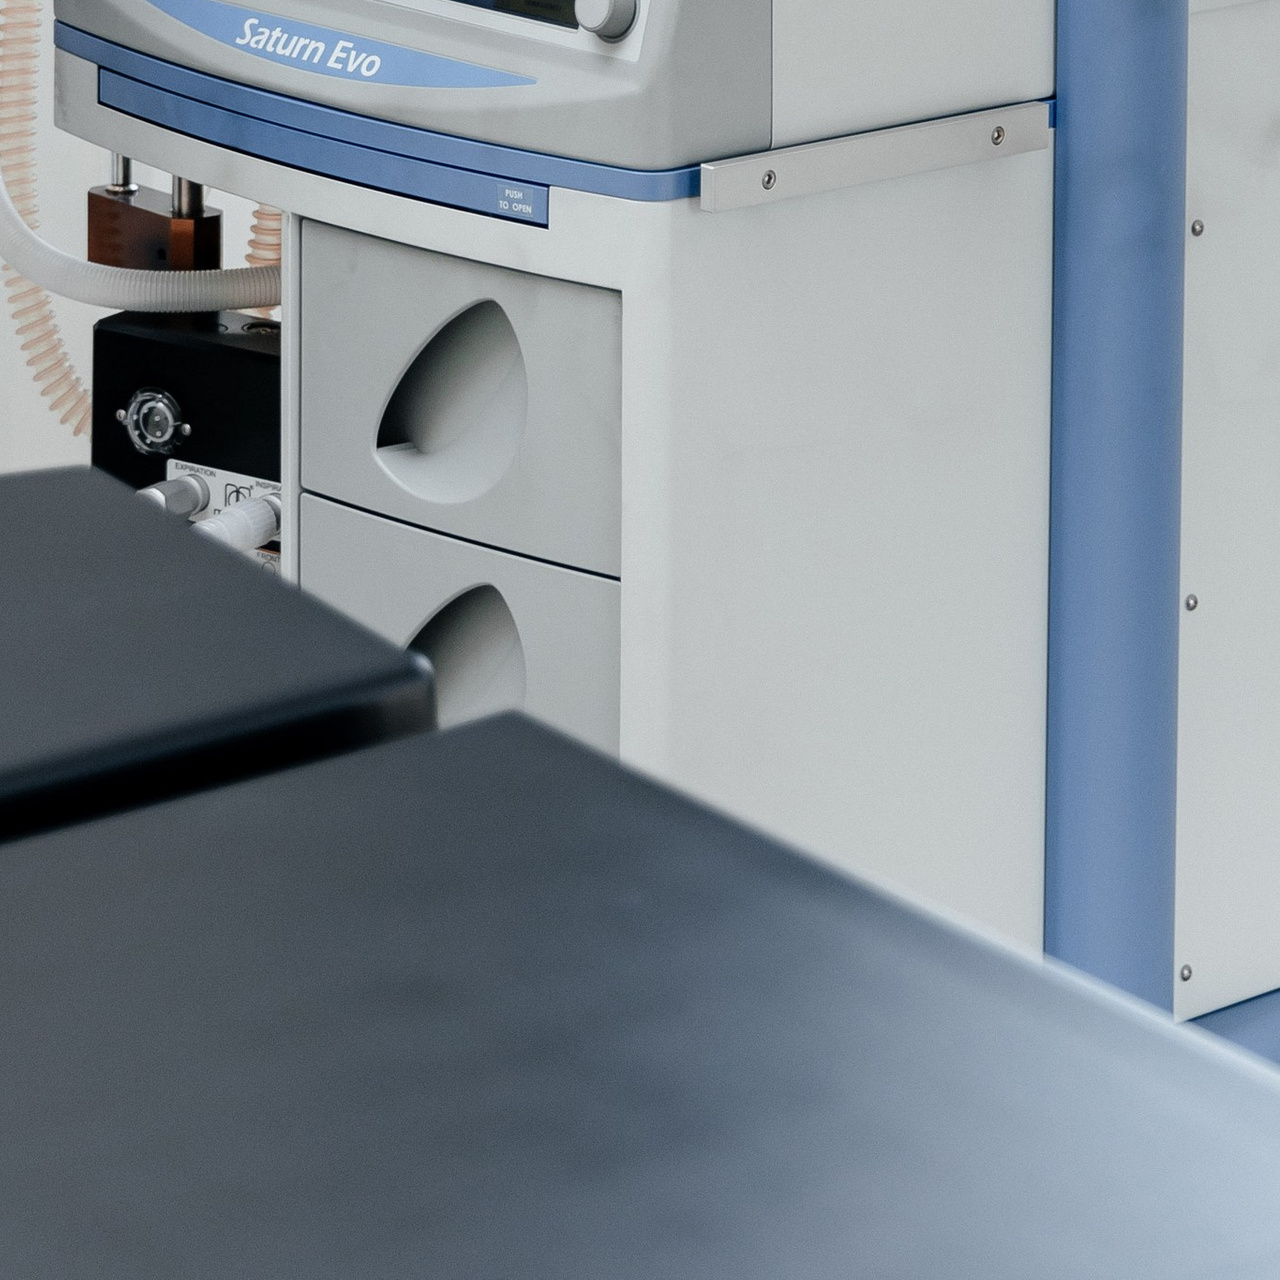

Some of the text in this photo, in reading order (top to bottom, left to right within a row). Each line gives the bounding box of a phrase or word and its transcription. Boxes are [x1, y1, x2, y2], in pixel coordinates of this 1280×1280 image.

[235, 18, 382, 77] Saturn Evo
[505, 189, 523, 200] PUSH
[499, 200, 532, 214] TO OPEN
[174, 462, 216, 478] EXPIRATION
